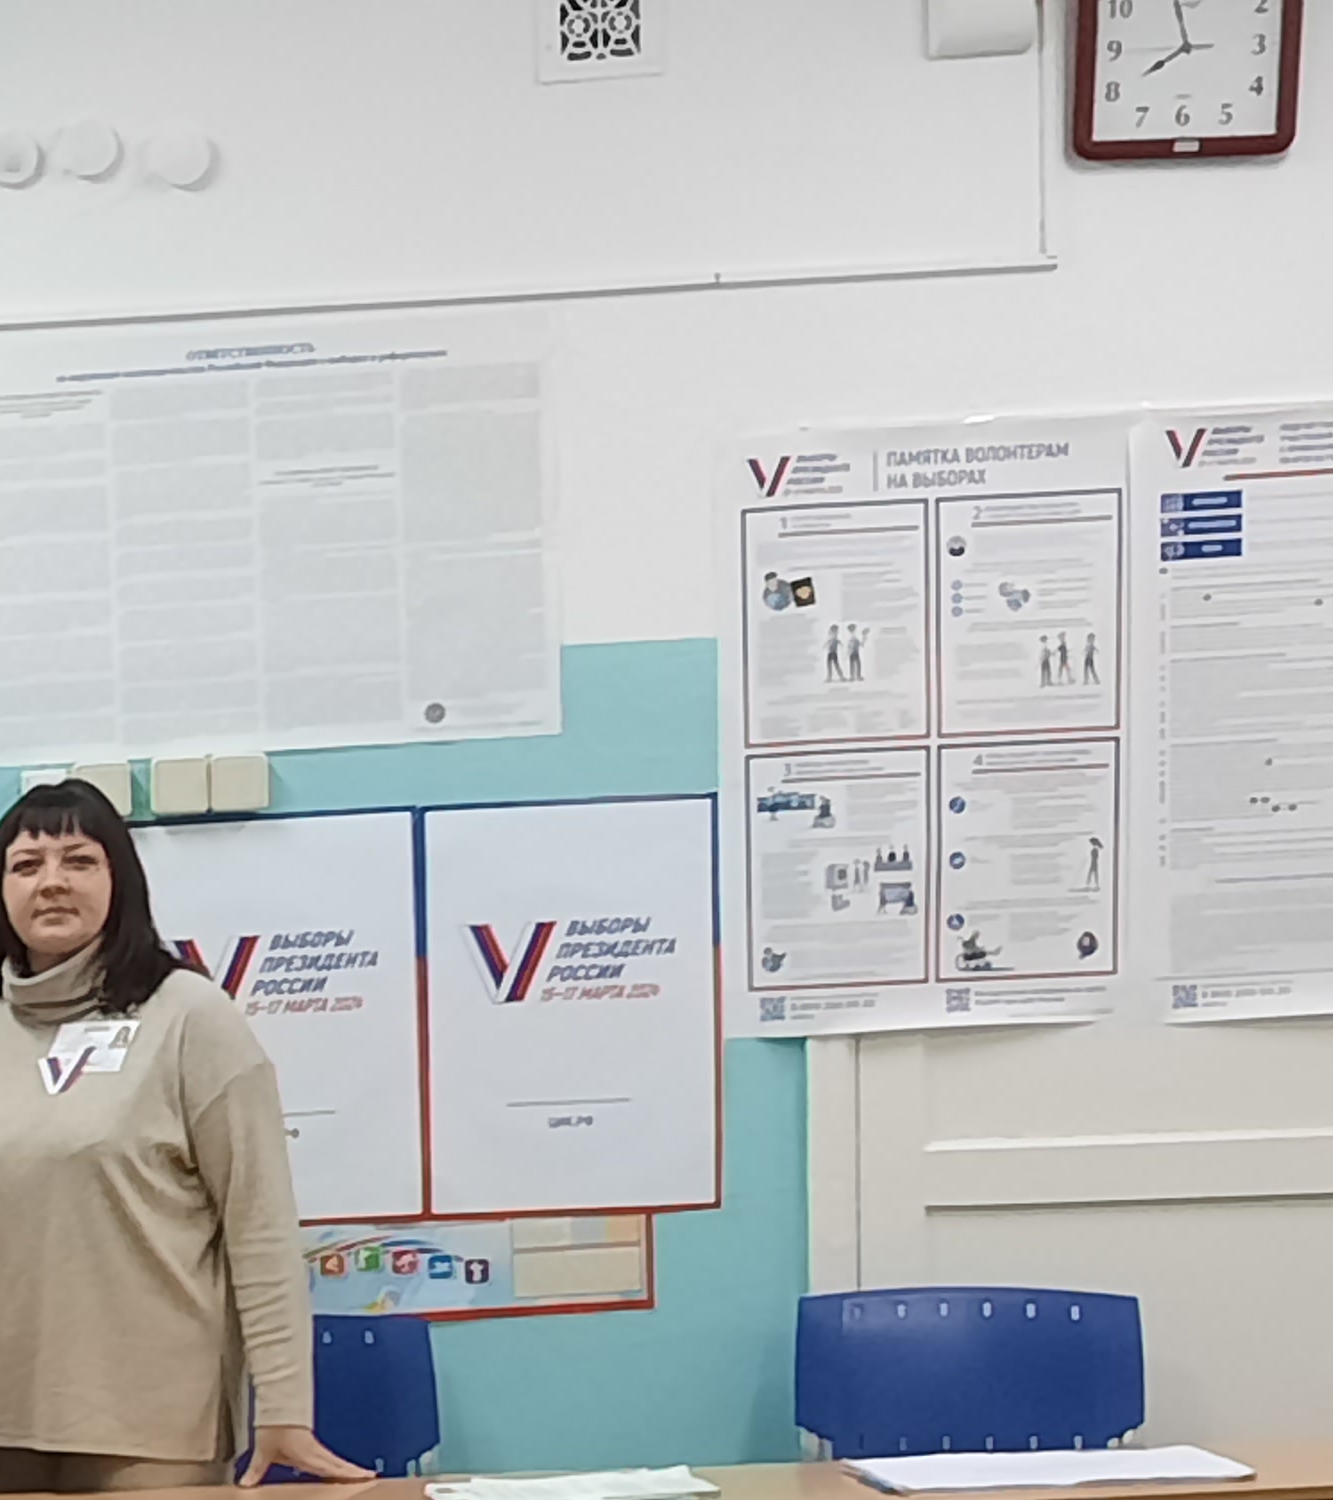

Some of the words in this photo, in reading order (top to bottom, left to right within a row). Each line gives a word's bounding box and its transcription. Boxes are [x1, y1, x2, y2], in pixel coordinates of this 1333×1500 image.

[886, 448, 961, 467] ПАМЯТКА
[965, 442, 1069, 464] ВОЛОНТЕРАМ
[887, 473, 909, 490] НА
[912, 469, 986, 489] ВЫБОРАХ
[565, 915, 652, 937] ВЫБОРЫ
[268, 929, 355, 951] ВЫБОРЫ
[555, 937, 677, 960] ПРЕЗИДЕНТА
[258, 951, 379, 974] ПРЕЗИДЕНТА
[545, 963, 627, 983] РОССИИ
[250, 976, 329, 997] РОССИИ
